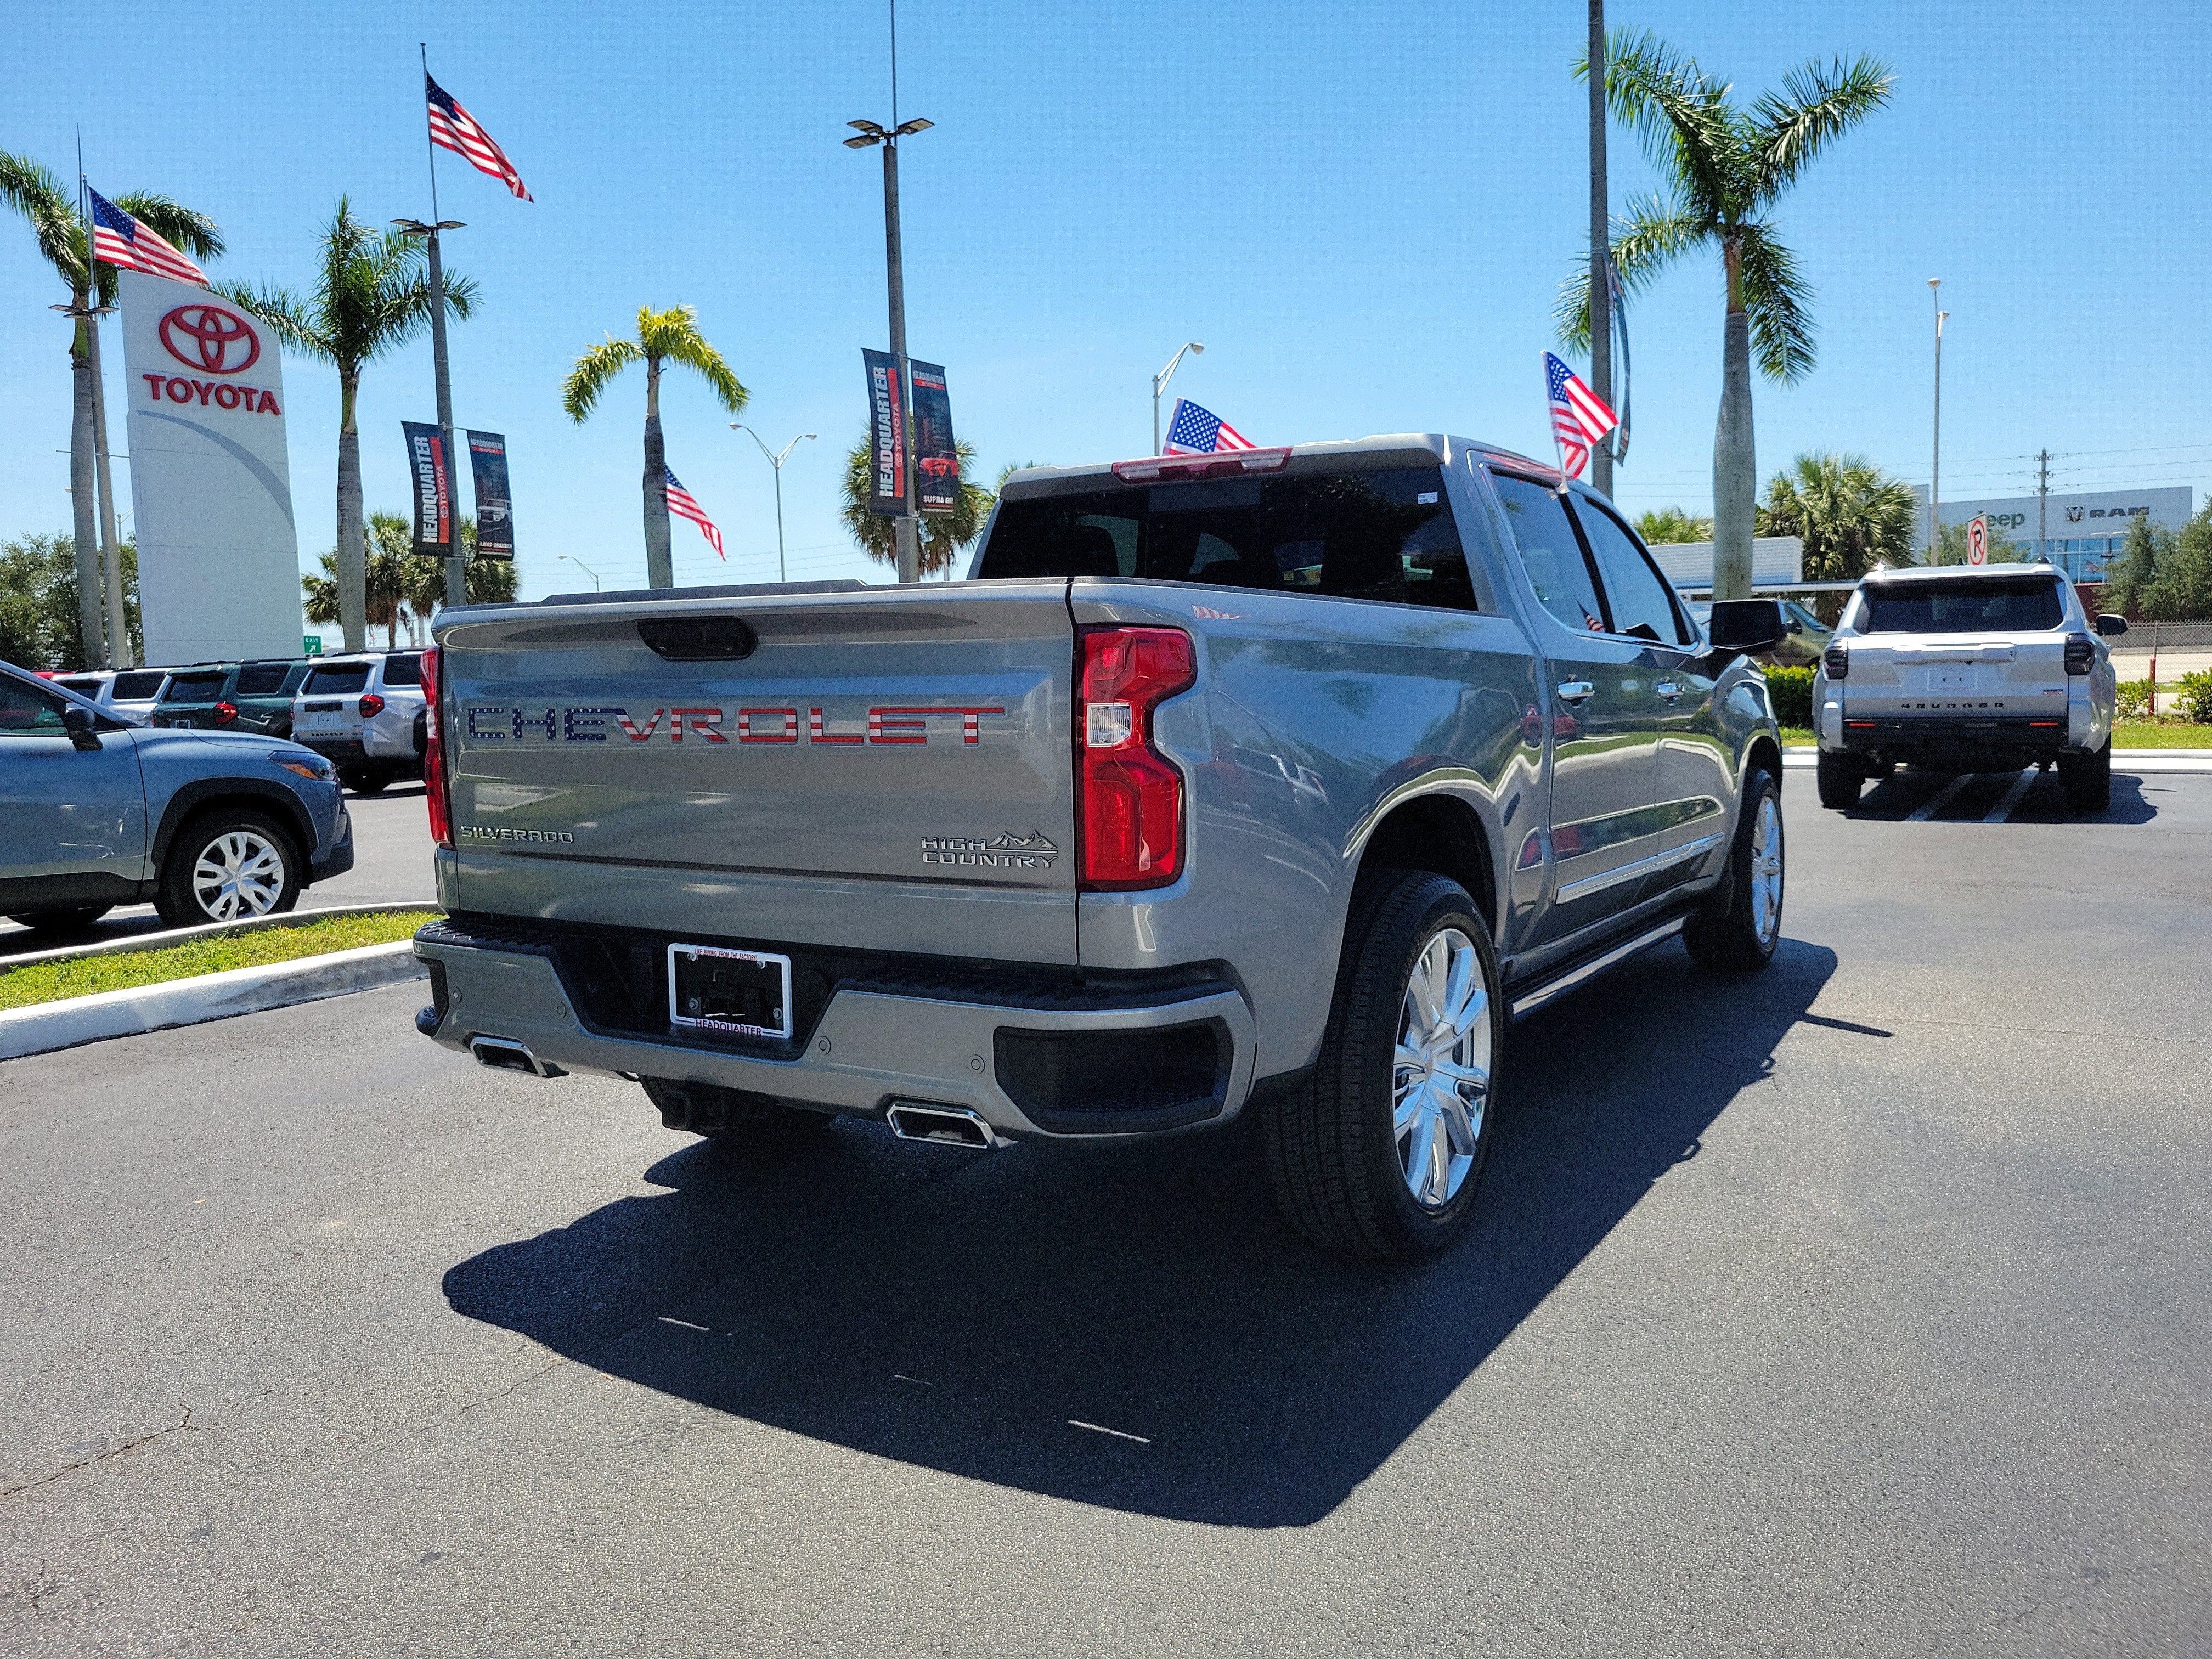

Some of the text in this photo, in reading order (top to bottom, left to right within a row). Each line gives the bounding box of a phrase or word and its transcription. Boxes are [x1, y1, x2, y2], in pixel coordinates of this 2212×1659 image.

[143, 374, 281, 415] TOYOTA
[872, 366, 894, 497] HEADQUARTER
[892, 403, 901, 451] TOYOTA
[414, 436, 438, 543] HEADQUARTER
[435, 465, 448, 505] TOYOTA
[923, 495, 944, 503] SUPRA
[1978, 511, 2025, 529] eep
[2089, 506, 2149, 518] RAM
[468, 707, 1005, 744] CHEVROLET
[460, 826, 575, 843] SILVERADO
[921, 837, 987, 851] HIGH
[922, 851, 1058, 868] COUNTRY
[696, 1019, 761, 1036] HEADQUARTER
